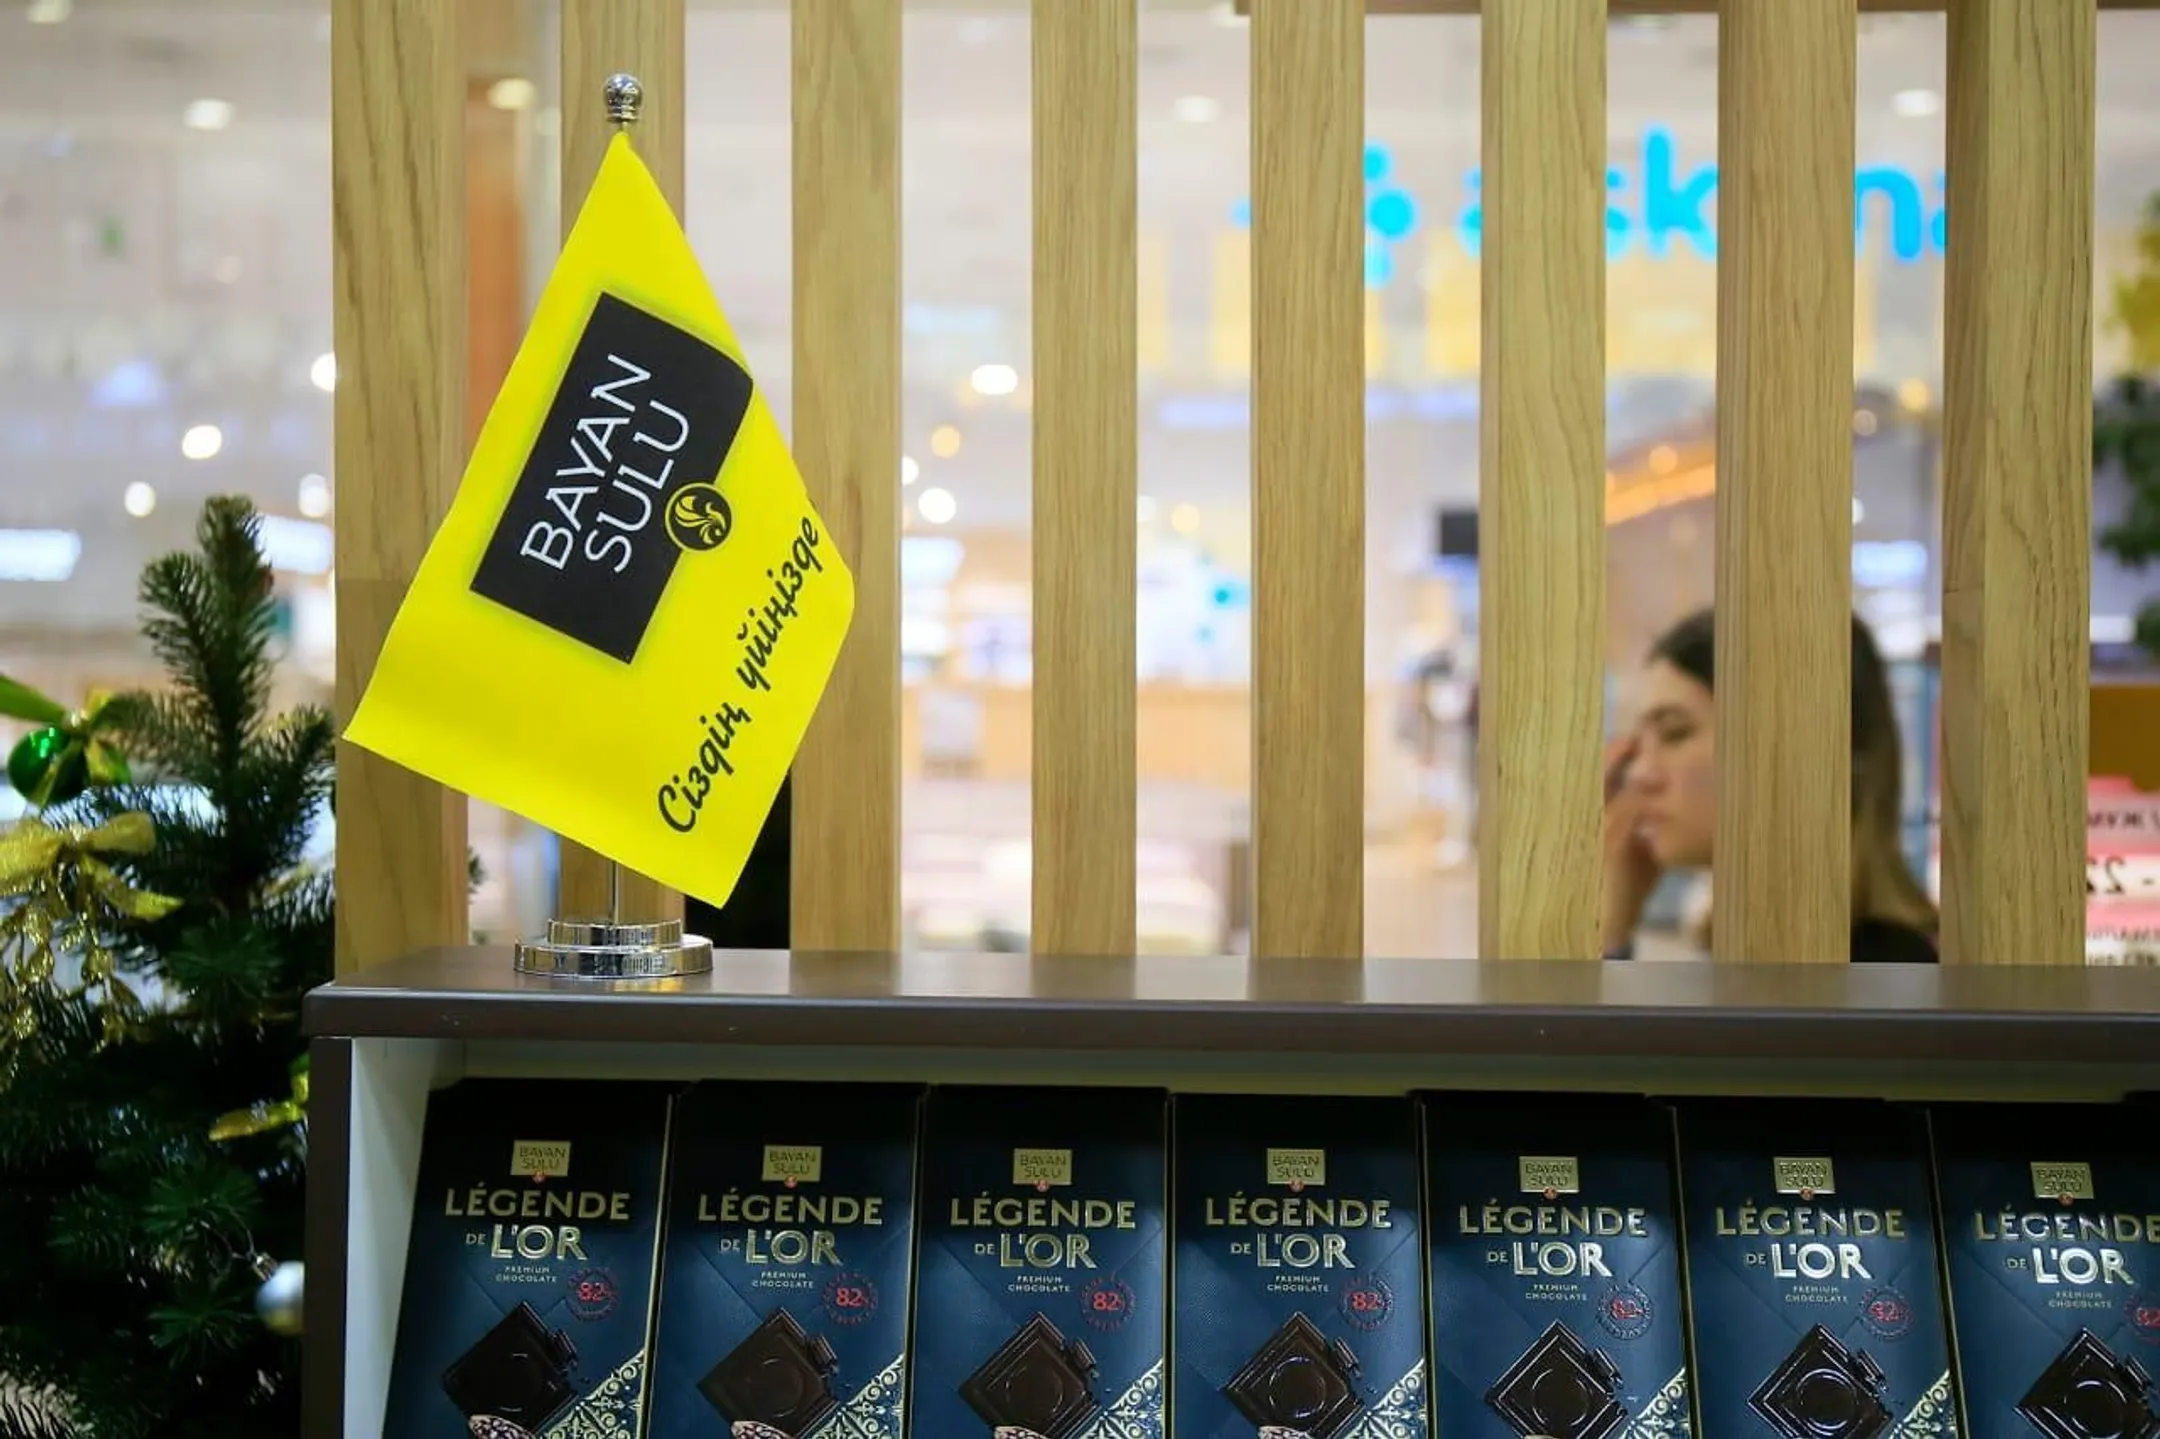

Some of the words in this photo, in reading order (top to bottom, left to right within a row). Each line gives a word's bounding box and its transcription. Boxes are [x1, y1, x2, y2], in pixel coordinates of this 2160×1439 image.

[520, 354, 651, 571] BAYAN
[584, 401, 690, 574] SULU
[658, 702, 752, 833] Сіздің
[519, 1147, 566, 1158] BAYAN
[522, 1158, 560, 1169] SULU
[769, 1151, 815, 1163] BAYAN
[774, 1163, 809, 1174] SULU
[1020, 1154, 1066, 1166] BAYAN
[1273, 1156, 1319, 1166] BAYAN
[1525, 1163, 1572, 1173] BAYAN
[1024, 1166, 1061, 1178] SULU
[1278, 1167, 1314, 1178] SULU
[1531, 1175, 1568, 1186] SULU
[445, 1181, 630, 1220] LÉGENDE
[698, 1188, 883, 1225] LÉGENDE
[950, 1192, 1135, 1228] LÉGENDE
[1206, 1192, 1391, 1228] LÉGENDE
[1459, 1198, 1648, 1236] LÉGENDE
[1716, 1197, 1905, 1237] LÉGENDE
[1973, 1204, 2160, 1243] LÉGENDE
[466, 1233, 486, 1245] DE
[491, 1224, 588, 1260] L'OR
[720, 1239, 740, 1251] DE
[746, 1229, 844, 1265] L'OR
[975, 1244, 994, 1254] DE
[1000, 1233, 1097, 1268] L'OR
[1231, 1243, 1251, 1254] DE
[1257, 1233, 1355, 1268] L'OR
[1488, 1251, 1508, 1263] DE
[1513, 1242, 1613, 1276] L'OR
[1746, 1253, 1766, 1264] DE
[1771, 1243, 1874, 1279] L'OR
[2007, 1258, 2027, 1268] DE
[2032, 1247, 2135, 1284] L'OR
[496, 1274, 557, 1283] CHOCOLATE
[752, 1280, 814, 1288] CHOCOLATE
[1268, 1284, 1329, 1292] CHOCOLATE
[1526, 1292, 1588, 1300] CHOCOLATE
[2048, 1300, 2112, 1308] CHOCOLATE
